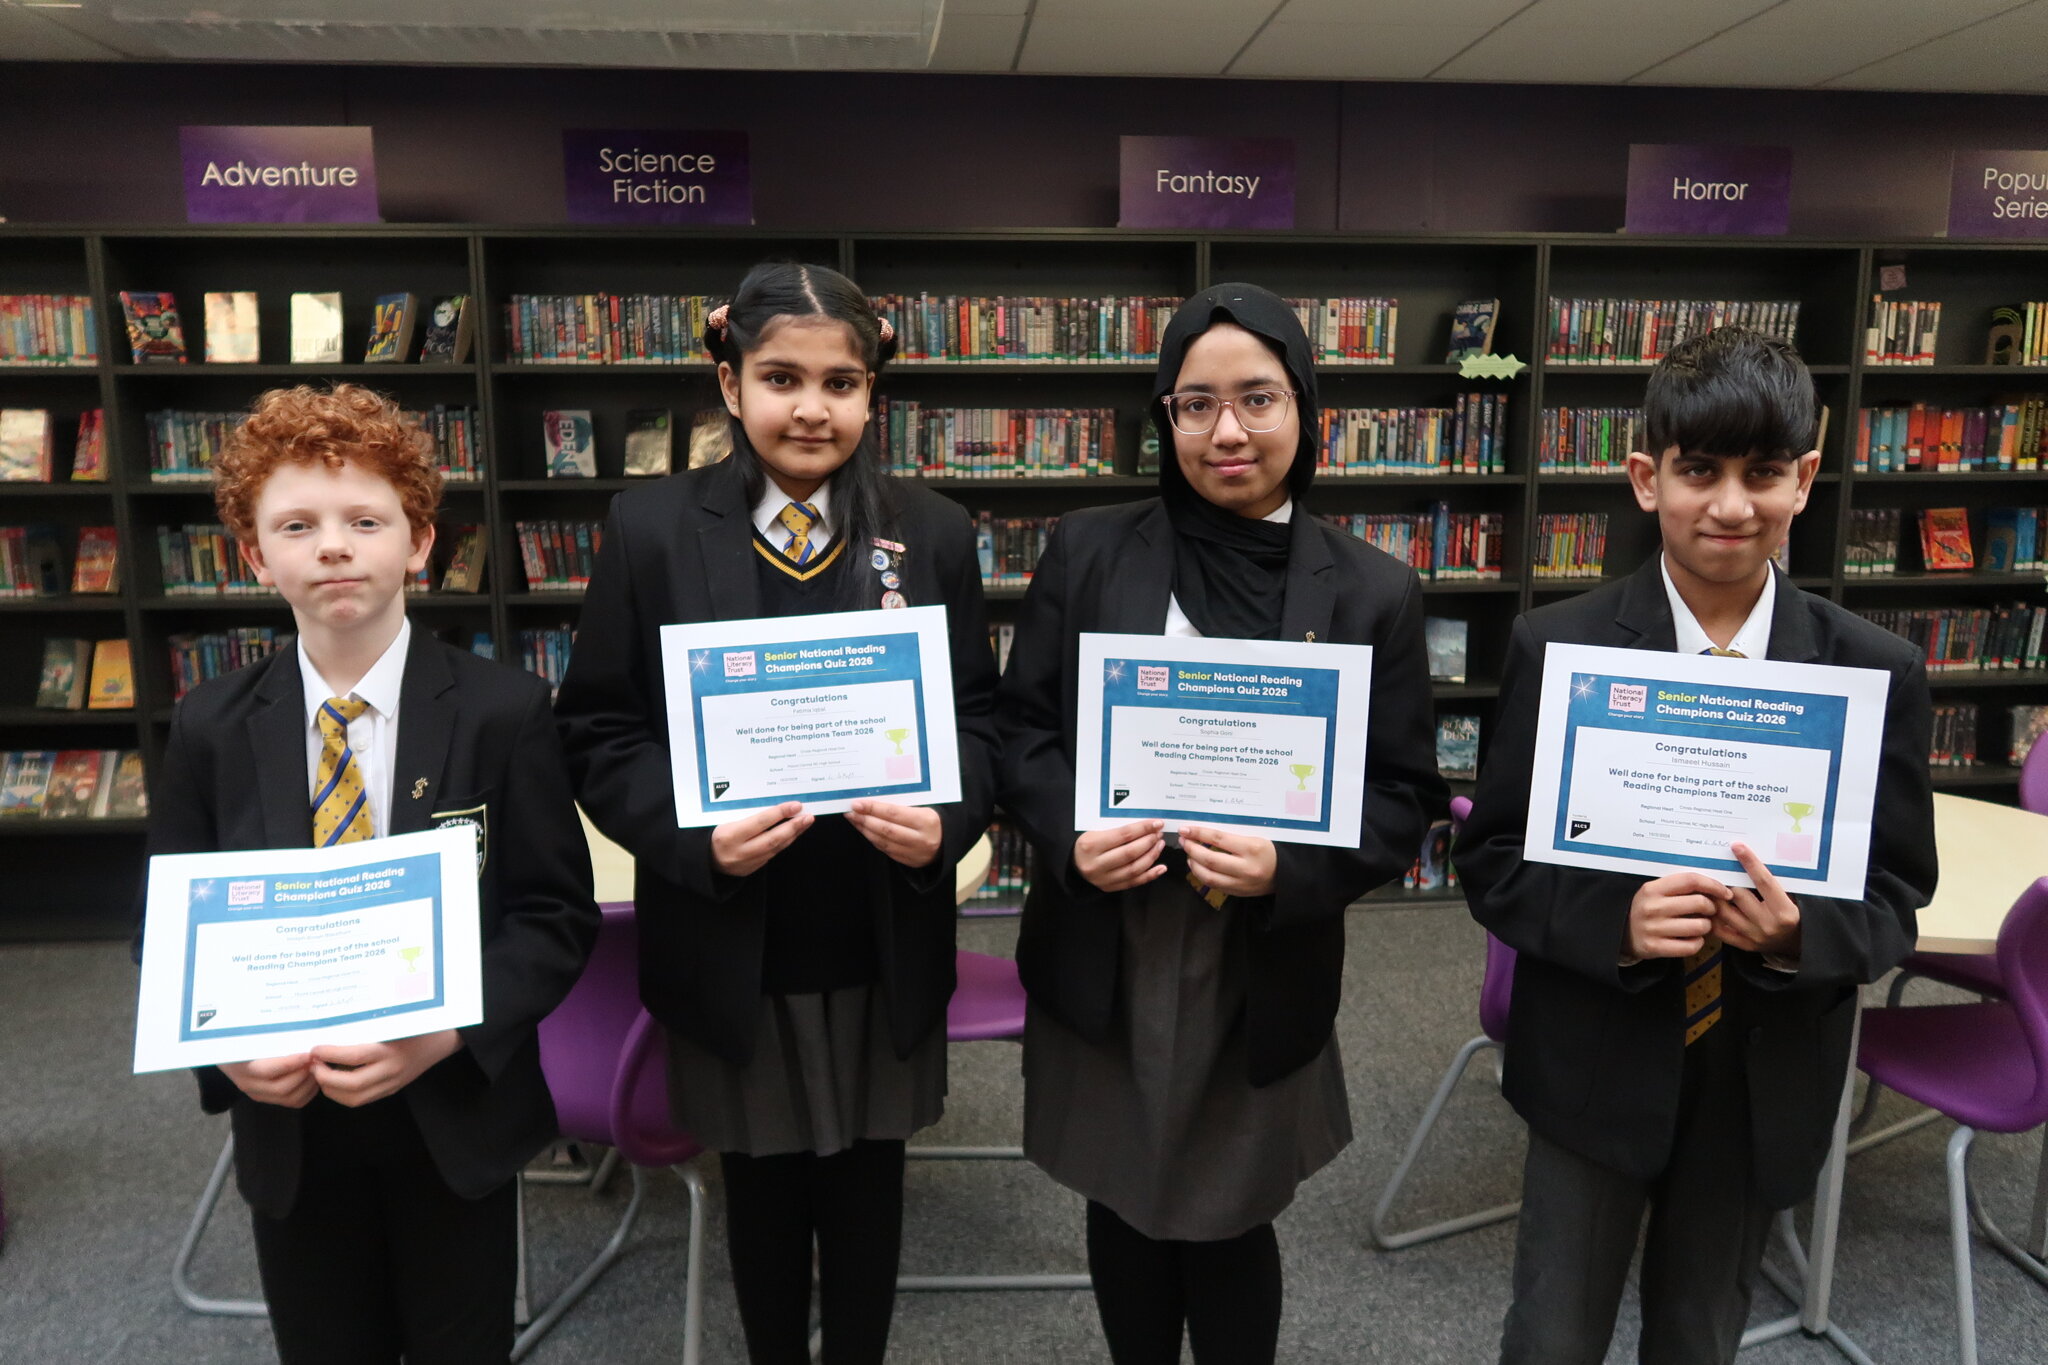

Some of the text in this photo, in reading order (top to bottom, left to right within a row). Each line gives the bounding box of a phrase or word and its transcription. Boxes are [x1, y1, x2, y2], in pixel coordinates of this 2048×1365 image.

[599, 147, 716, 173] Science
[201, 160, 358, 187] Adventure
[613, 179, 706, 204] Fiction
[1157, 169, 1260, 199] Fantasy
[1673, 177, 1749, 200] Horror
[559, 419, 577, 462] EDEN
[764, 645, 886, 661] Senior National Reading
[765, 656, 873, 673] Champions Quiz 2026
[1140, 675, 1165, 683] Literacy
[1177, 671, 1302, 687] Senior National Reading
[1177, 682, 1287, 696] Champions Quiz 2026
[1612, 693, 1642, 703] Literacy
[1613, 687, 1643, 696] National
[770, 693, 848, 707] Congratulations
[1656, 690, 1804, 716] Senior National Reading
[1178, 716, 1256, 728] Congratulations
[1655, 703, 1786, 725] Champions Quiz 2026
[735, 726, 754, 736] Well
[754, 726, 775, 734] done
[790, 722, 813, 731] being
[814, 720, 832, 731] part
[834, 719, 843, 727] of
[844, 718, 858, 726] the
[859, 715, 886, 725] school
[749, 735, 783, 744] Reading
[784, 732, 830, 741] Champions
[854, 727, 873, 735] 2026
[1443, 731, 1472, 741] DUST
[1141, 740, 1158, 748] Well
[1160, 741, 1180, 749] done
[1181, 742, 1194, 750] for
[1195, 743, 1218, 753] being
[1219, 745, 1238, 754] part
[1249, 746, 1263, 754] the
[1265, 747, 1292, 756] school
[1654, 741, 1748, 759] Congratulations
[1154, 751, 1278, 765] Reading Champions Team 2026
[1701, 759, 1730, 768] Hussain
[1608, 767, 1788, 793] Well done for being part of the school
[1622, 780, 1771, 803] Reading Champions Team 2026
[274, 868, 405, 890] Senior National Reading
[274, 879, 391, 902] Champions Quiz 2026
[276, 918, 360, 934] Congratulations
[231, 954, 252, 962] Well
[295, 949, 320, 958] being
[322, 945, 341, 957] part
[343, 943, 352, 951] of
[354, 941, 369, 949] the
[371, 935, 400, 946] school
[246, 947, 386, 971] Reading Champions Team 2026
